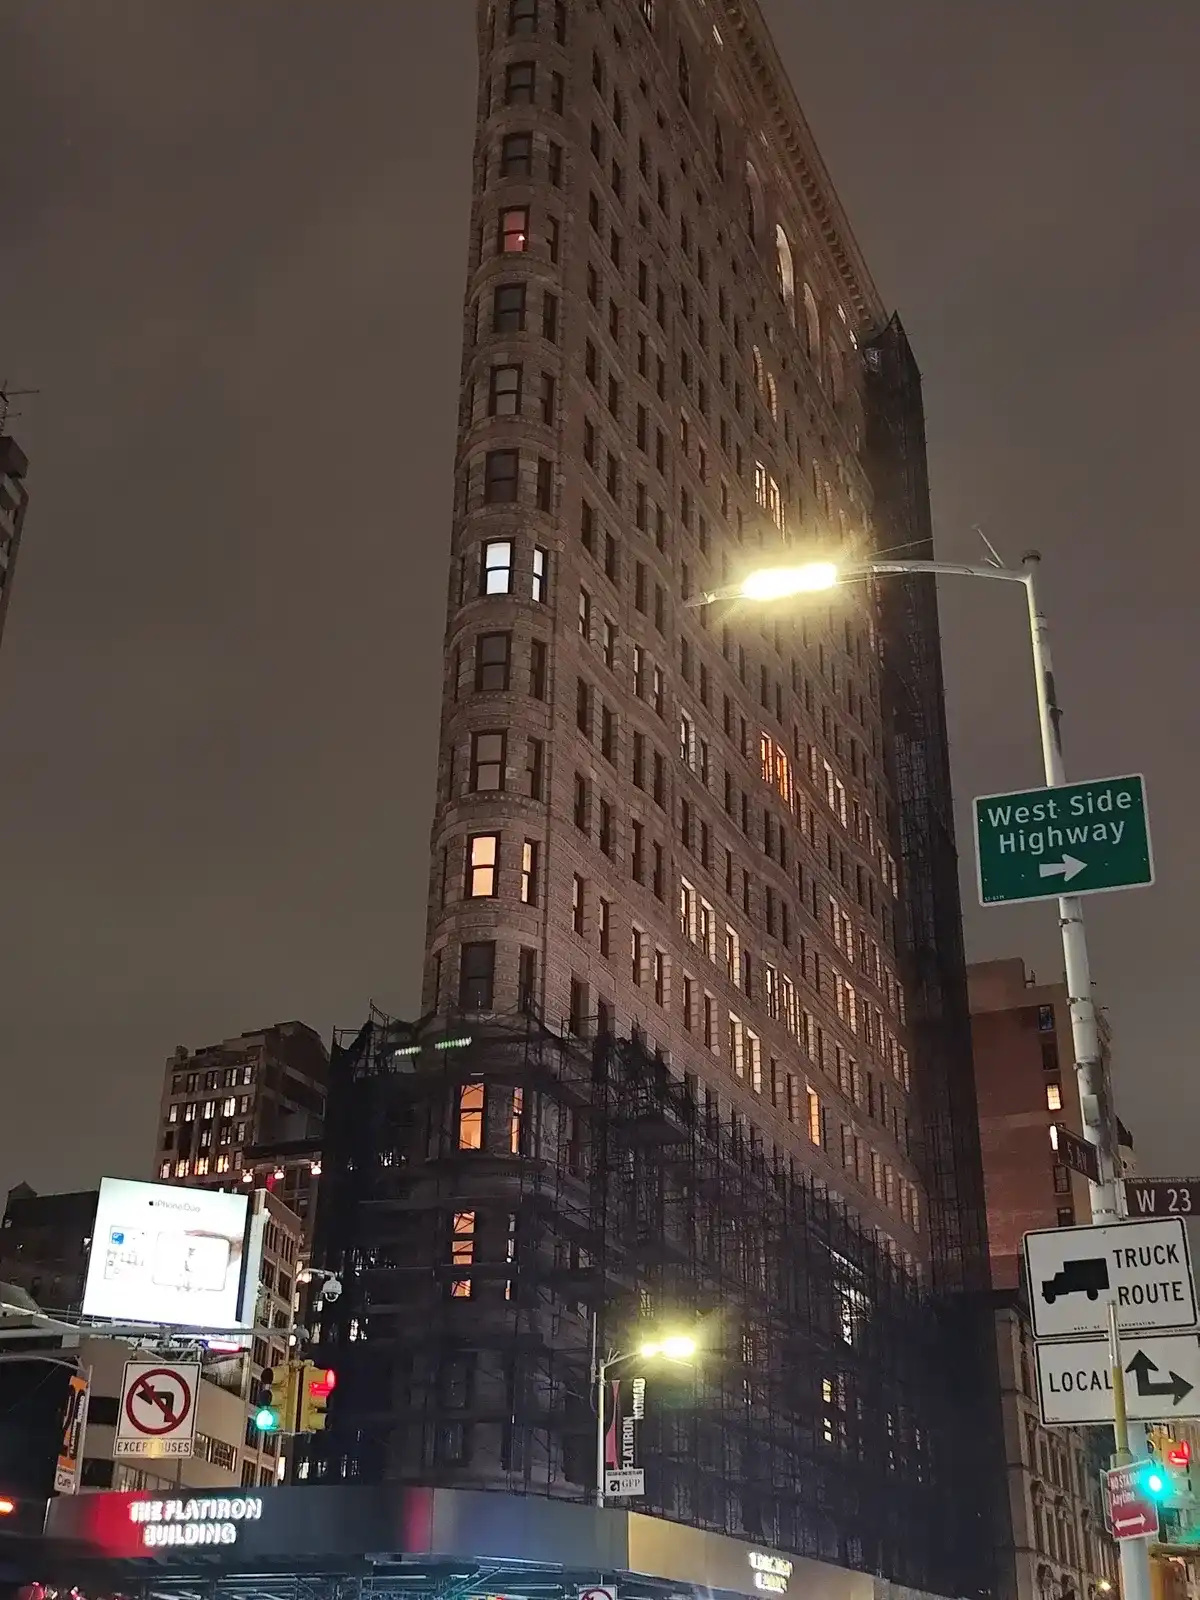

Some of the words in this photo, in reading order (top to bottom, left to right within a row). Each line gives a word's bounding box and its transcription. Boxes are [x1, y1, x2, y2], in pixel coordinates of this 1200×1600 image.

[988, 798, 1058, 827] West
[1070, 790, 1132, 816] Side
[999, 820, 1125, 855] Highway
[154, 1200, 183, 1211] iPhone
[1136, 1189, 1155, 1212] W
[1167, 1189, 1191, 1212] 23
[1112, 1244, 1179, 1269] TRUCK
[1117, 1281, 1184, 1306] ROUTE
[1049, 1370, 1114, 1393] LOCAL
[633, 1378, 646, 1420] NOMAD
[117, 1441, 154, 1452] EXCEPT
[623, 1416, 634, 1470] FLATIRON
[1109, 1475, 1120, 1490] NO
[130, 1501, 163, 1521] THE
[164, 1498, 262, 1520] FLATIRON
[144, 1523, 237, 1546] BUILDING
